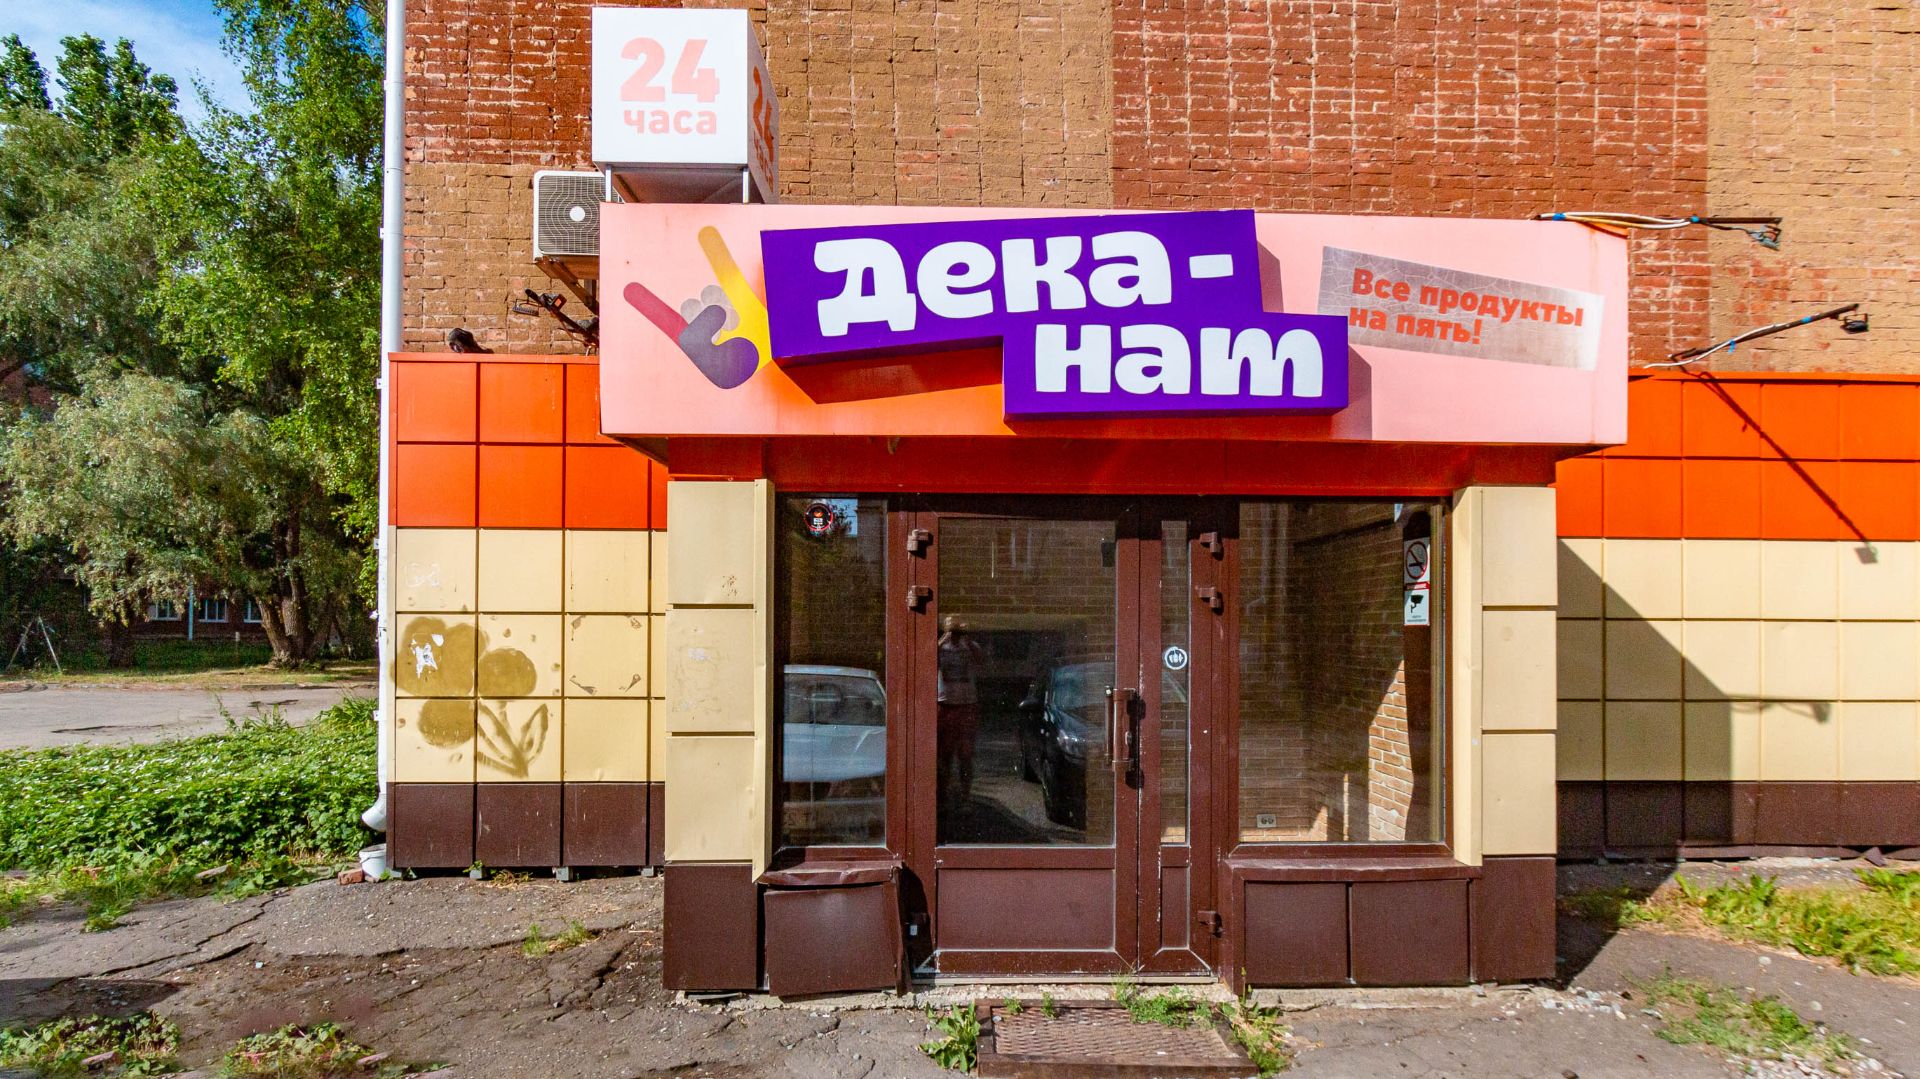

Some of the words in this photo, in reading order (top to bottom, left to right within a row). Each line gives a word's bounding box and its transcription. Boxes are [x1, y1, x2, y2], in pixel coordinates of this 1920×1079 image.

[620, 37, 720, 103] 24
[623, 109, 717, 135] часа
[1349, 307, 1387, 332] на
[1396, 314, 1483, 345] пять!
[1352, 268, 1411, 302] Все
[1419, 285, 1584, 327] продукты
[1035, 323, 1324, 398] нат
